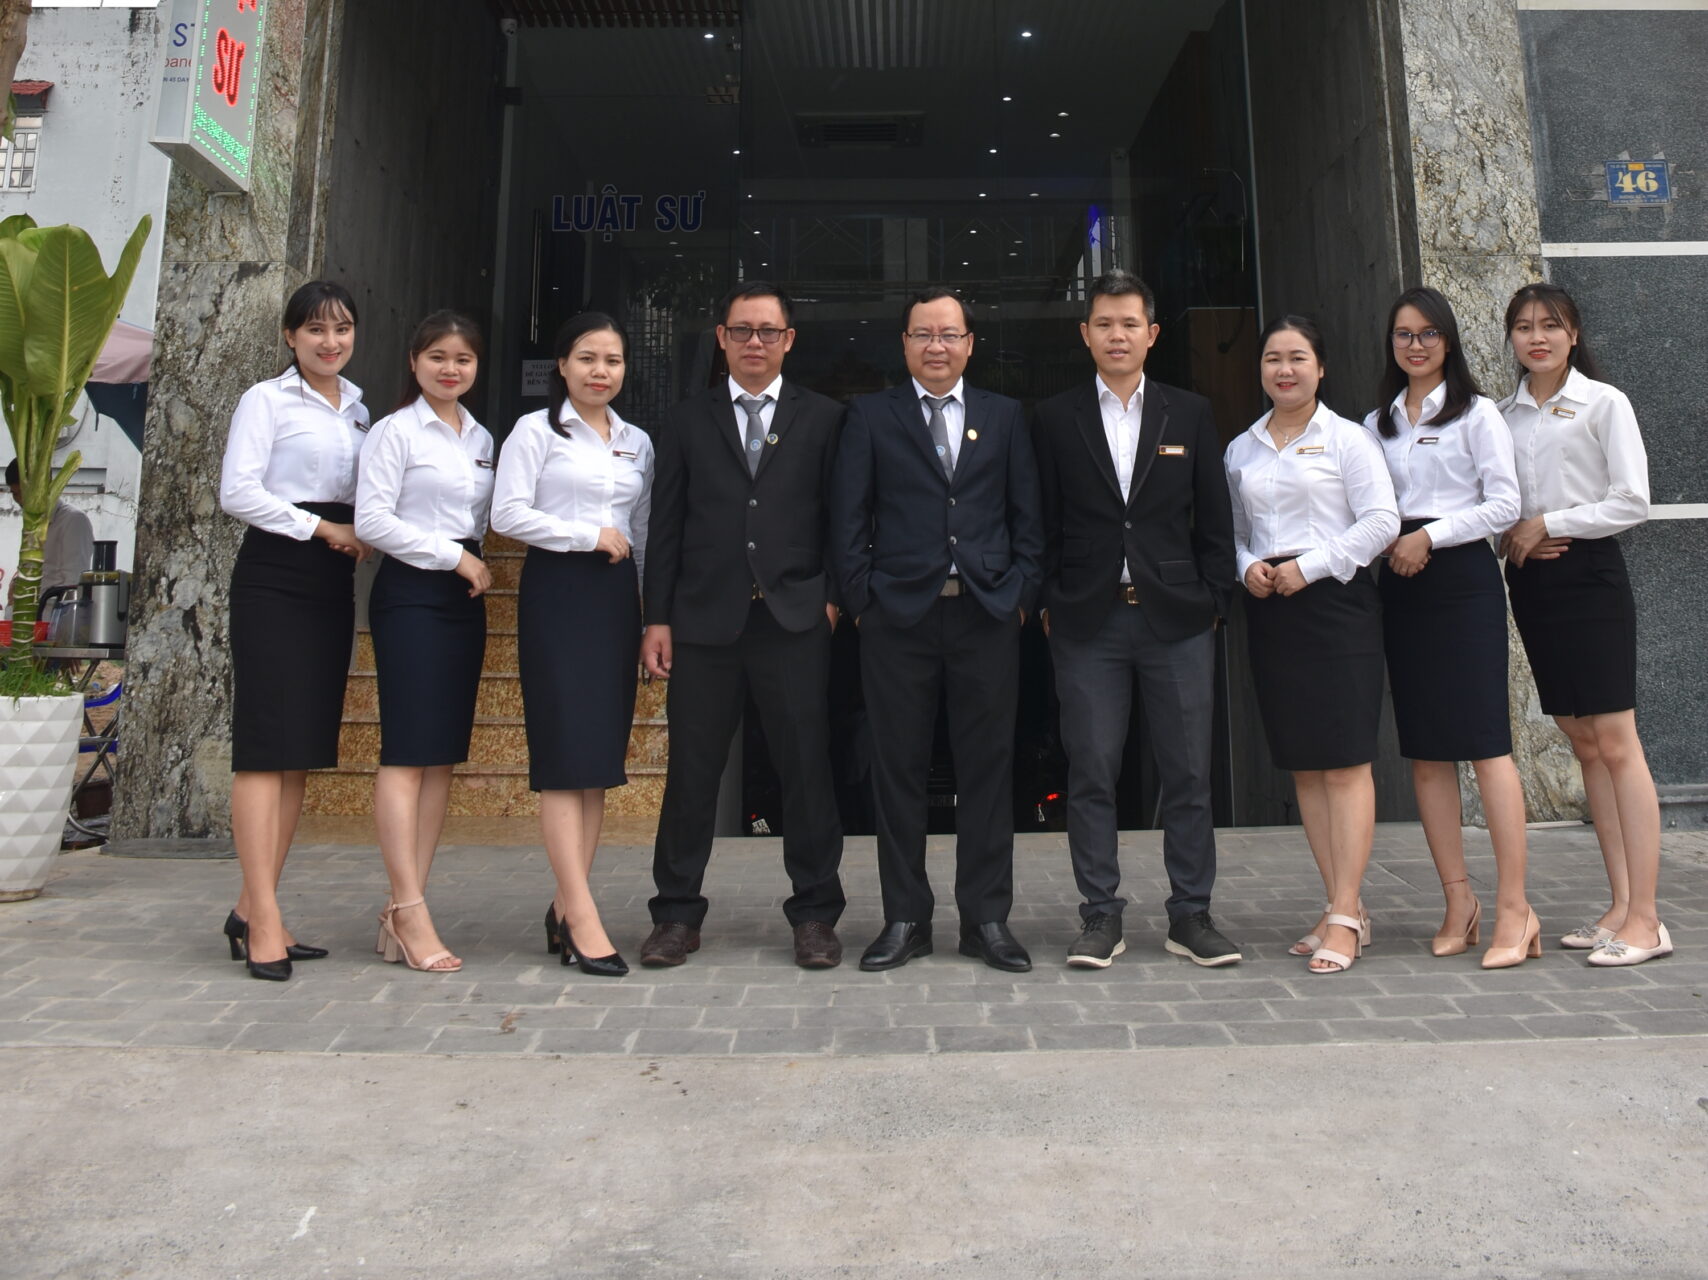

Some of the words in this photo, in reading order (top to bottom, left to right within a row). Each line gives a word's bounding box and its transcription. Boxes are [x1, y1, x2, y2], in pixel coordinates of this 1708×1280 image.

[212, 27, 246, 107] SƯ
[1614, 170, 1659, 193] 46
[551, 184, 643, 242] LUẬT
[654, 190, 707, 232] SƯ
